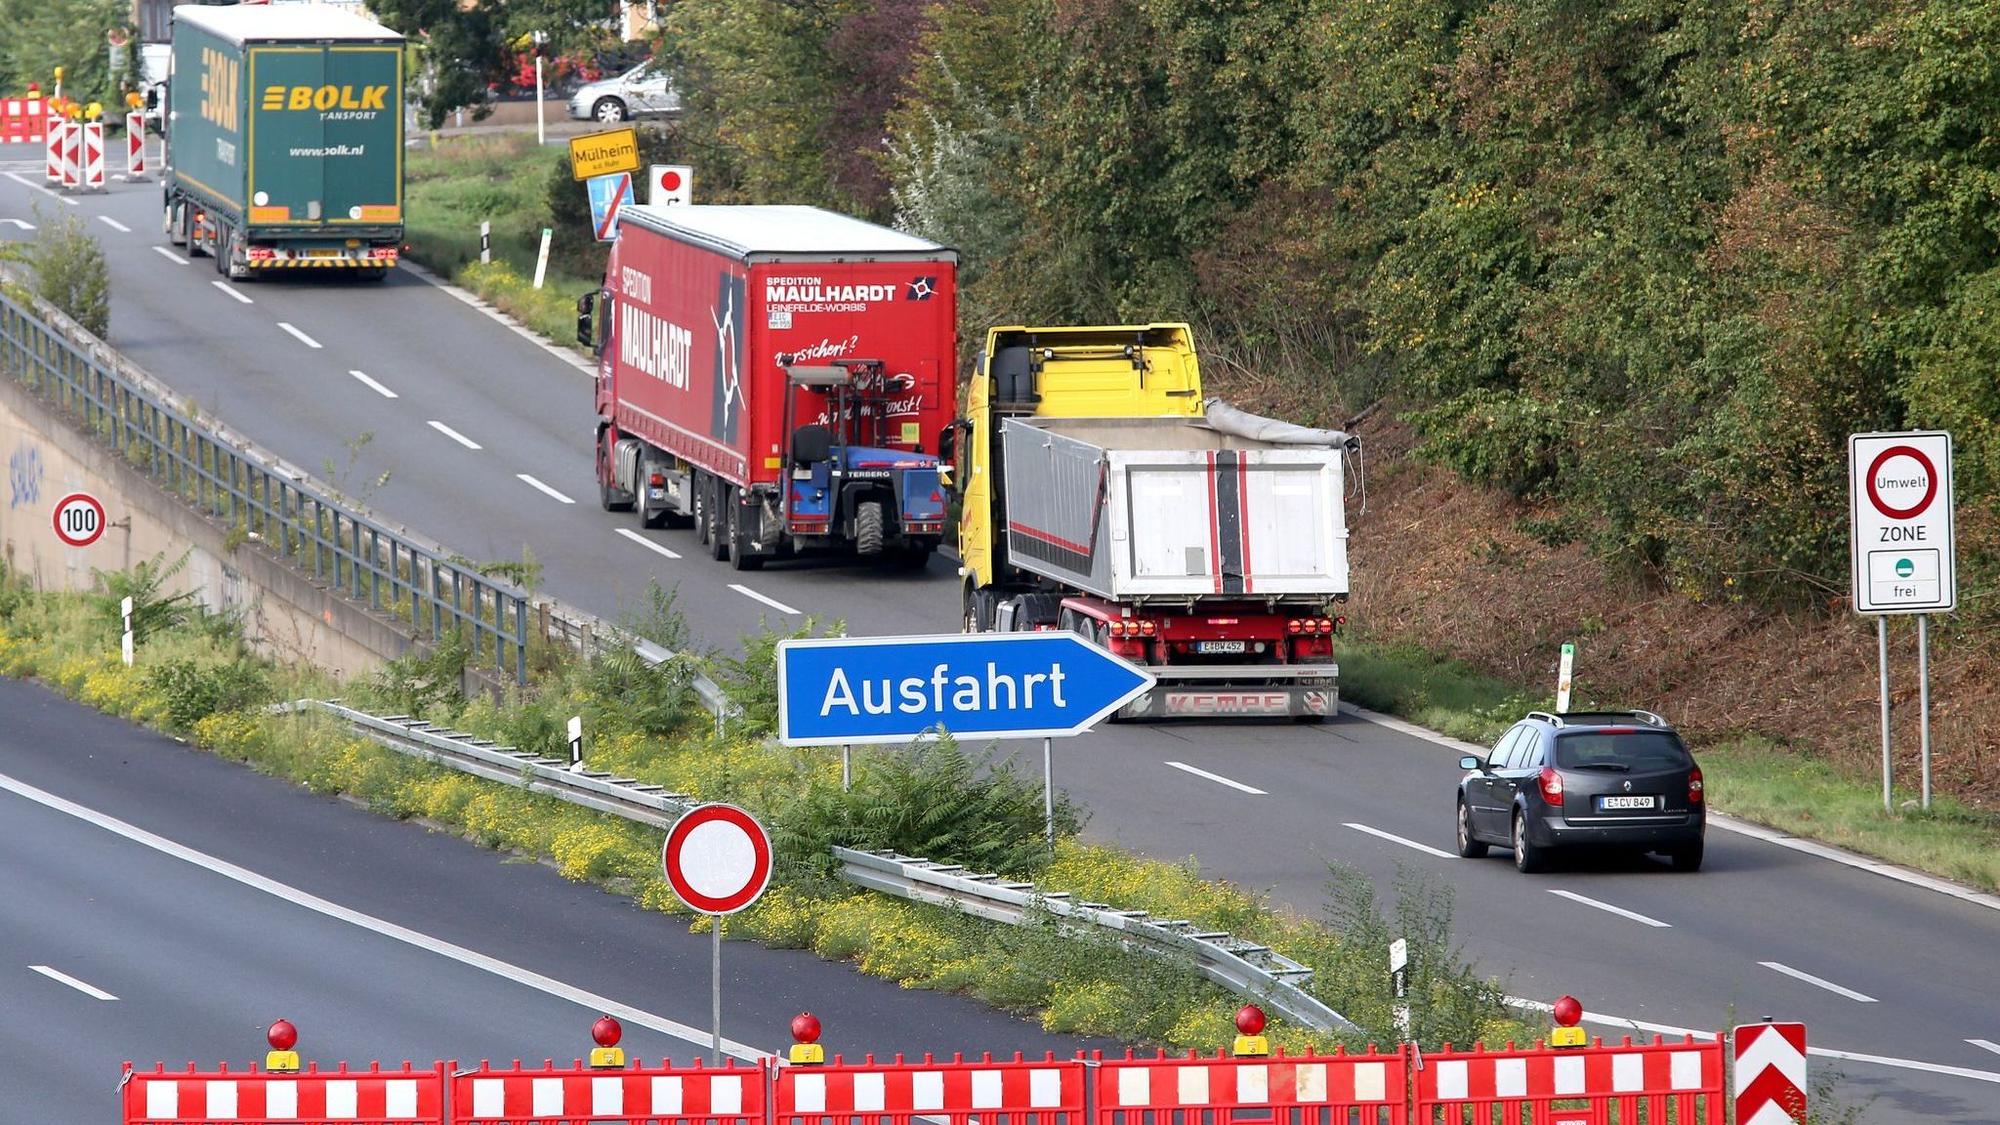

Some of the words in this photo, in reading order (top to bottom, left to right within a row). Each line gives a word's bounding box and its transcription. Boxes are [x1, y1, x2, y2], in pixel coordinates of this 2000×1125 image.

[288, 85, 389, 110] BOLK
[320, 111, 377, 121] TANSPORT
[575, 144, 634, 164] Mülheim
[766, 277, 822, 286] SPEDITION
[766, 285, 896, 302] MAULHARDT
[766, 303, 867, 313] LEINEFELDE-WORBIS
[622, 302, 692, 392] MAULHARDT
[1877, 476, 1927, 489] Umwelt
[64, 508, 95, 532] 100
[1880, 526, 1927, 542] ZONE
[1894, 585, 1916, 597] frei
[1226, 642, 1241, 650] 452
[820, 662, 1067, 717] Ausfahrt
[1170, 695, 1285, 713] KEMPF
[1607, 799, 1614, 808] E
[1620, 799, 1632, 808] CV
[1633, 799, 1650, 807] 849
